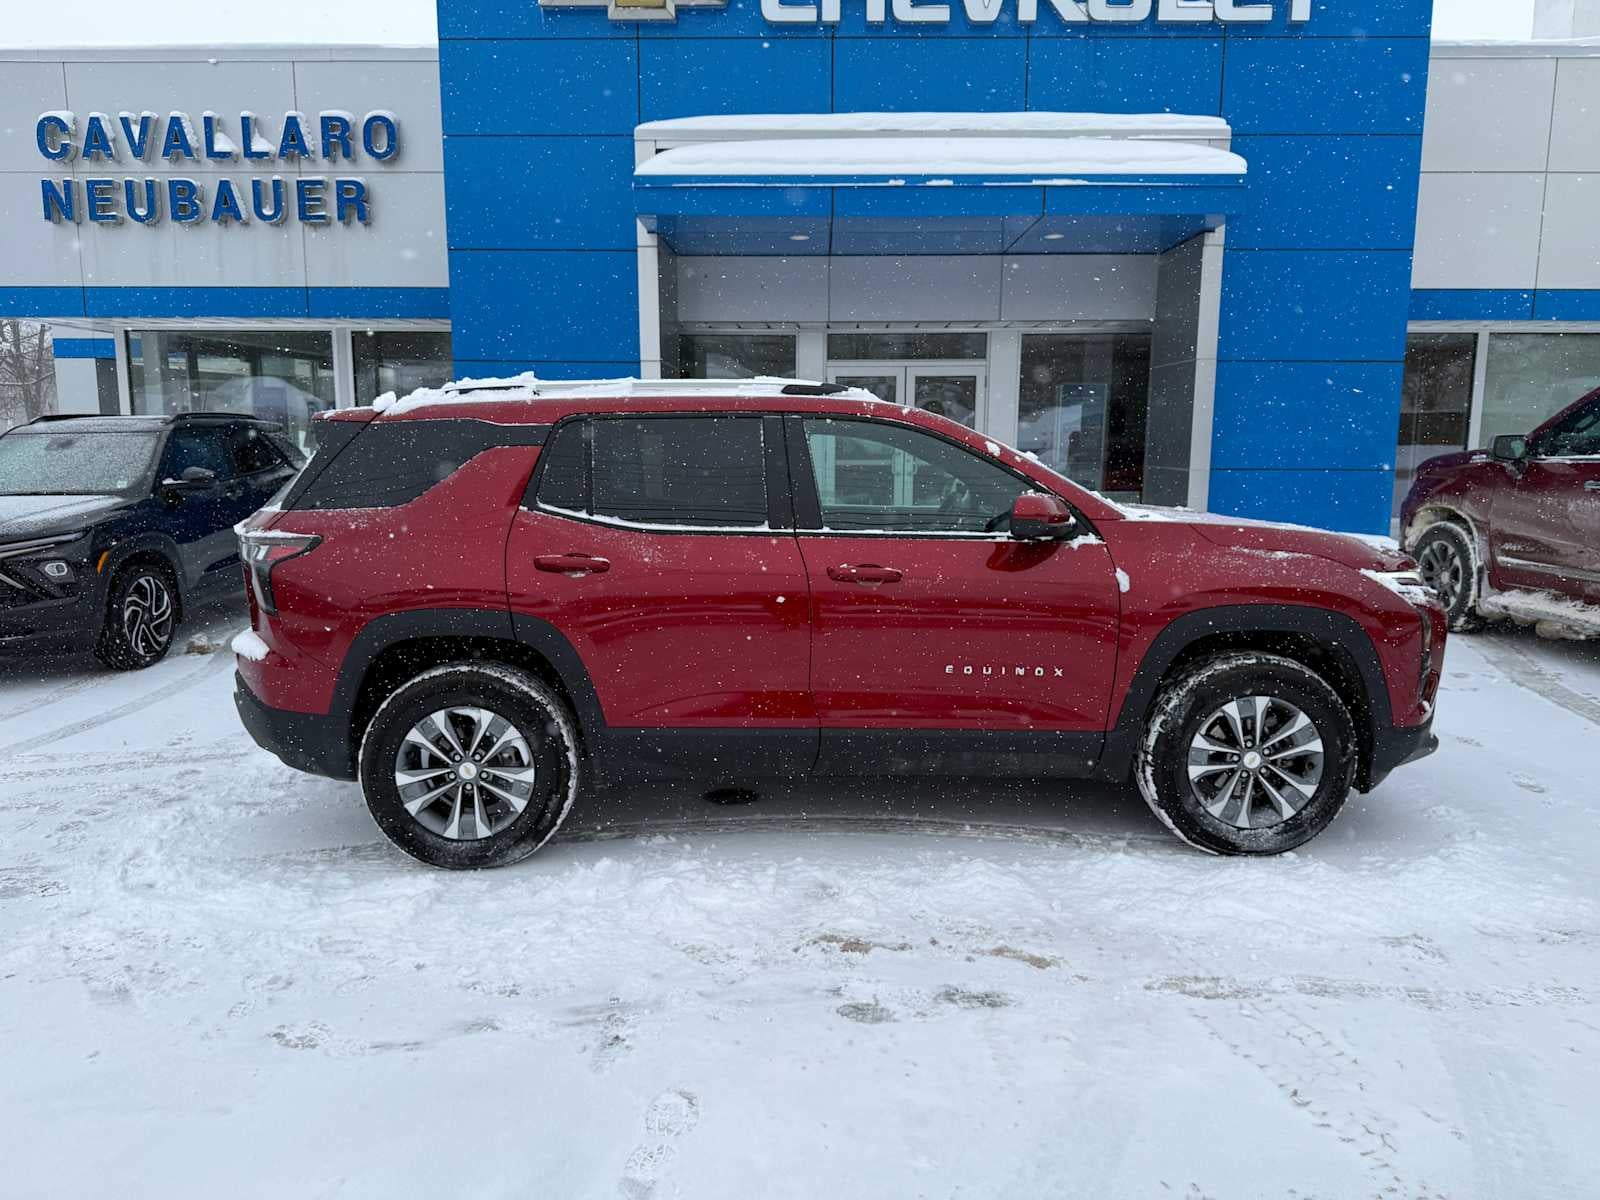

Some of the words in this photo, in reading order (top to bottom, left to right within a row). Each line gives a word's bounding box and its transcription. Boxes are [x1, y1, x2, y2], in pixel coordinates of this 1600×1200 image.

[36, 110, 399, 162] CAVALLARO
[41, 176, 370, 224] NEUBAUER
[945, 665, 1063, 677] EQUINOX
